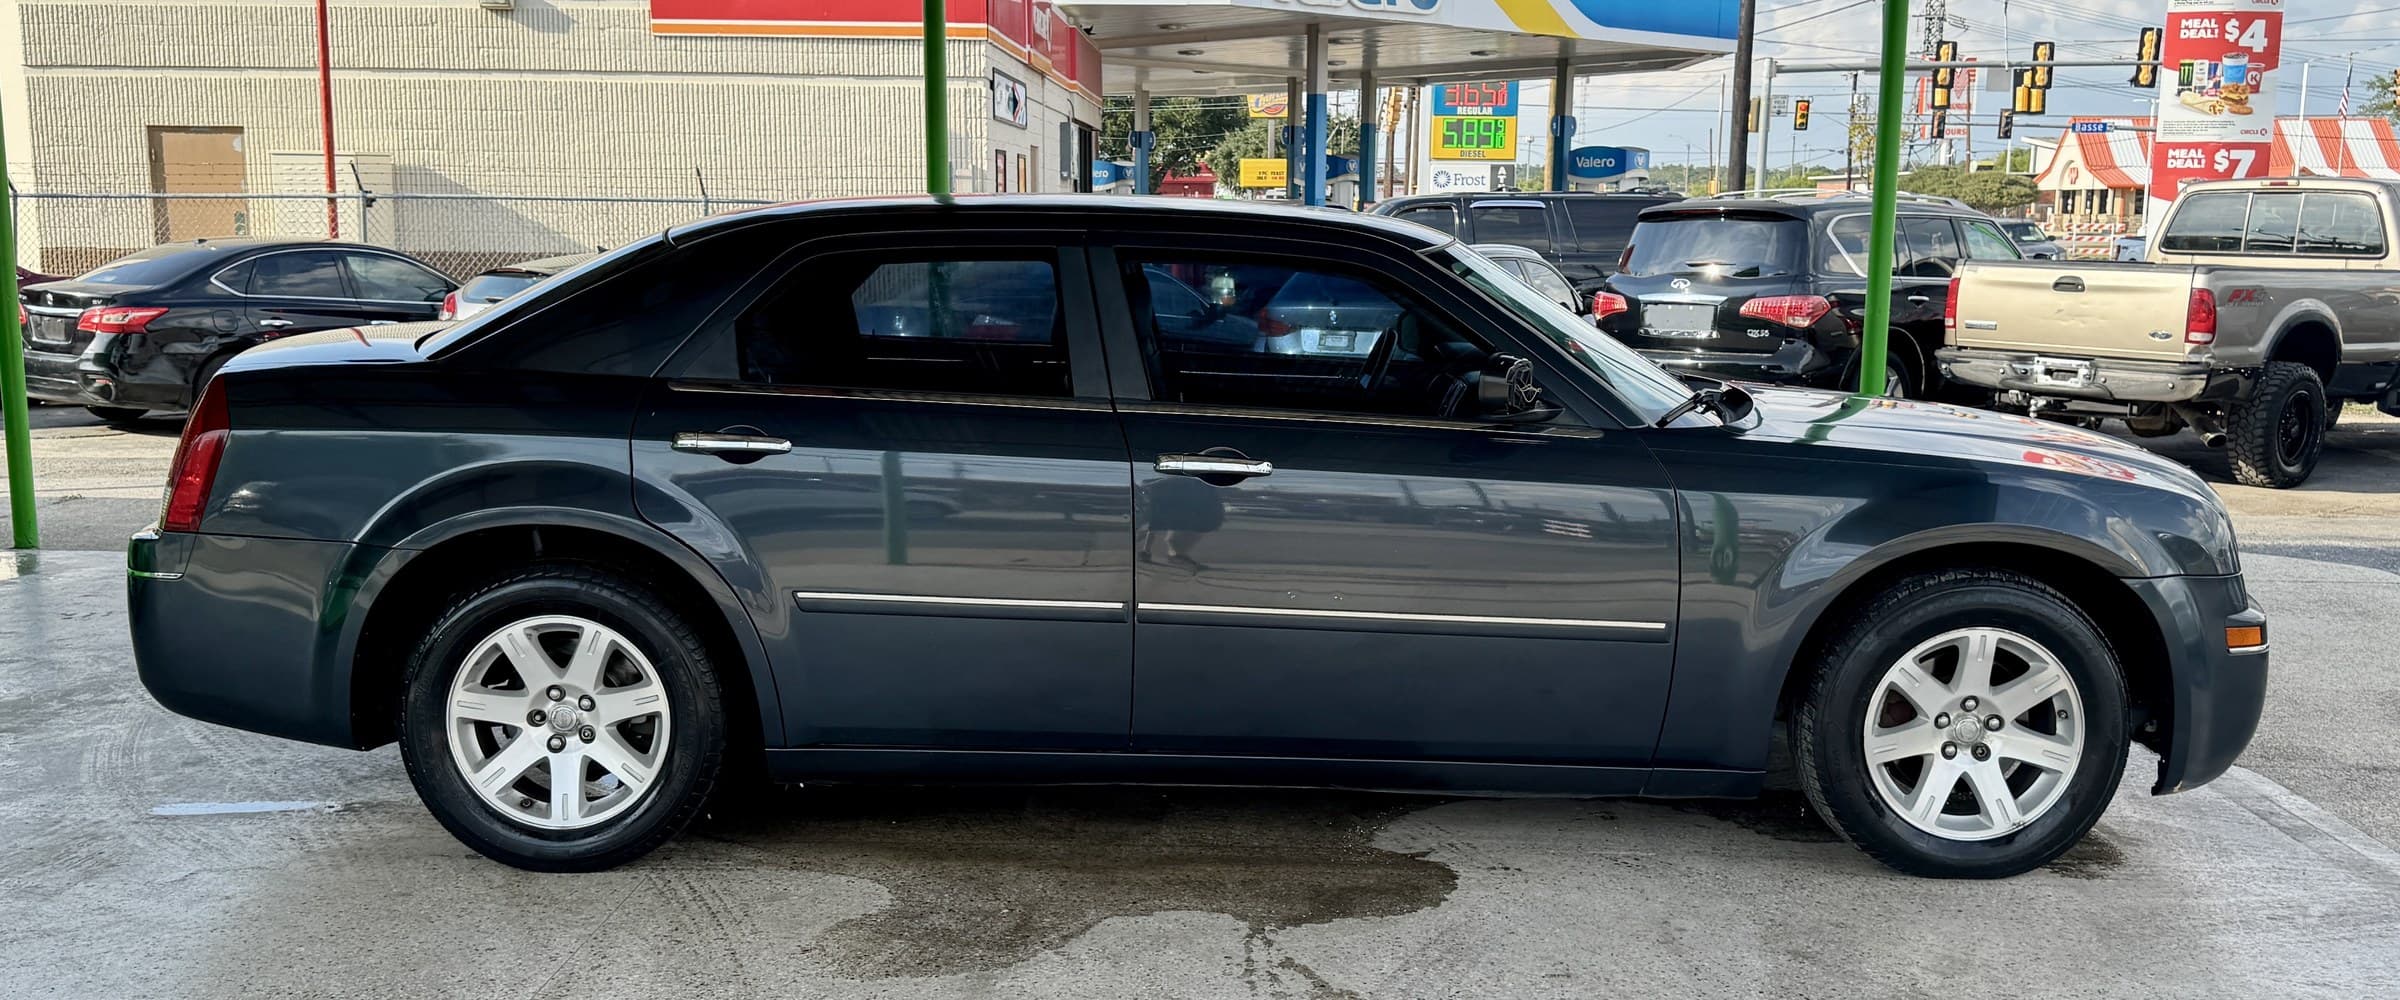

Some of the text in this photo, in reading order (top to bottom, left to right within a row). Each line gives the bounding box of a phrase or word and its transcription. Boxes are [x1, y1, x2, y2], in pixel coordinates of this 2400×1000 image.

[2181, 19, 2218, 28] MEAL
[2180, 29, 2218, 39] DEAL!
[2225, 19, 2268, 52] $4
[1457, 107, 1493, 115] REGULAR
[2168, 149, 2205, 158] MEAL
[1576, 157, 1615, 168] Valero
[2167, 159, 2205, 168] DEAL!
[2214, 149, 2256, 179] $7
[1454, 173, 1486, 186] Frost
